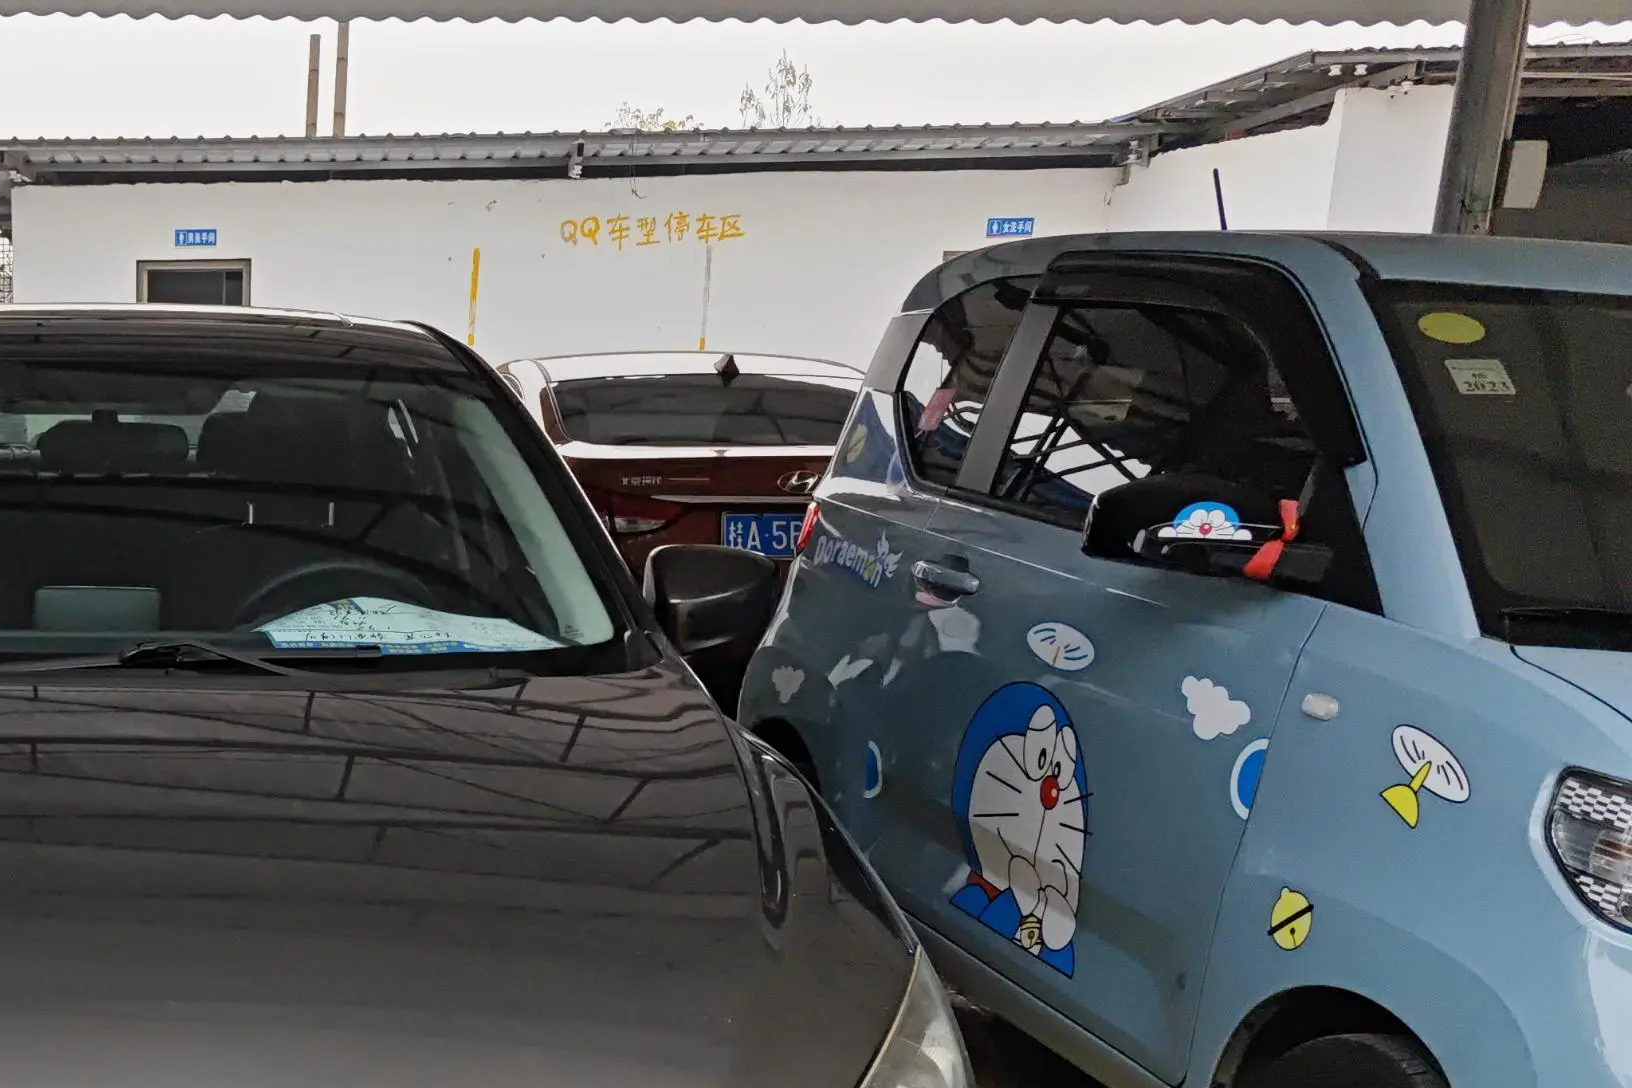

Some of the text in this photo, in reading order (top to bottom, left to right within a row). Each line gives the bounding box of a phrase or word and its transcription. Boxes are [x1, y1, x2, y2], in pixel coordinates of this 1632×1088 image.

[560, 211, 746, 250] QQ车型停车区
[1002, 220, 1033, 234] 女洗手间
[812, 535, 884, 588] Doraemon
